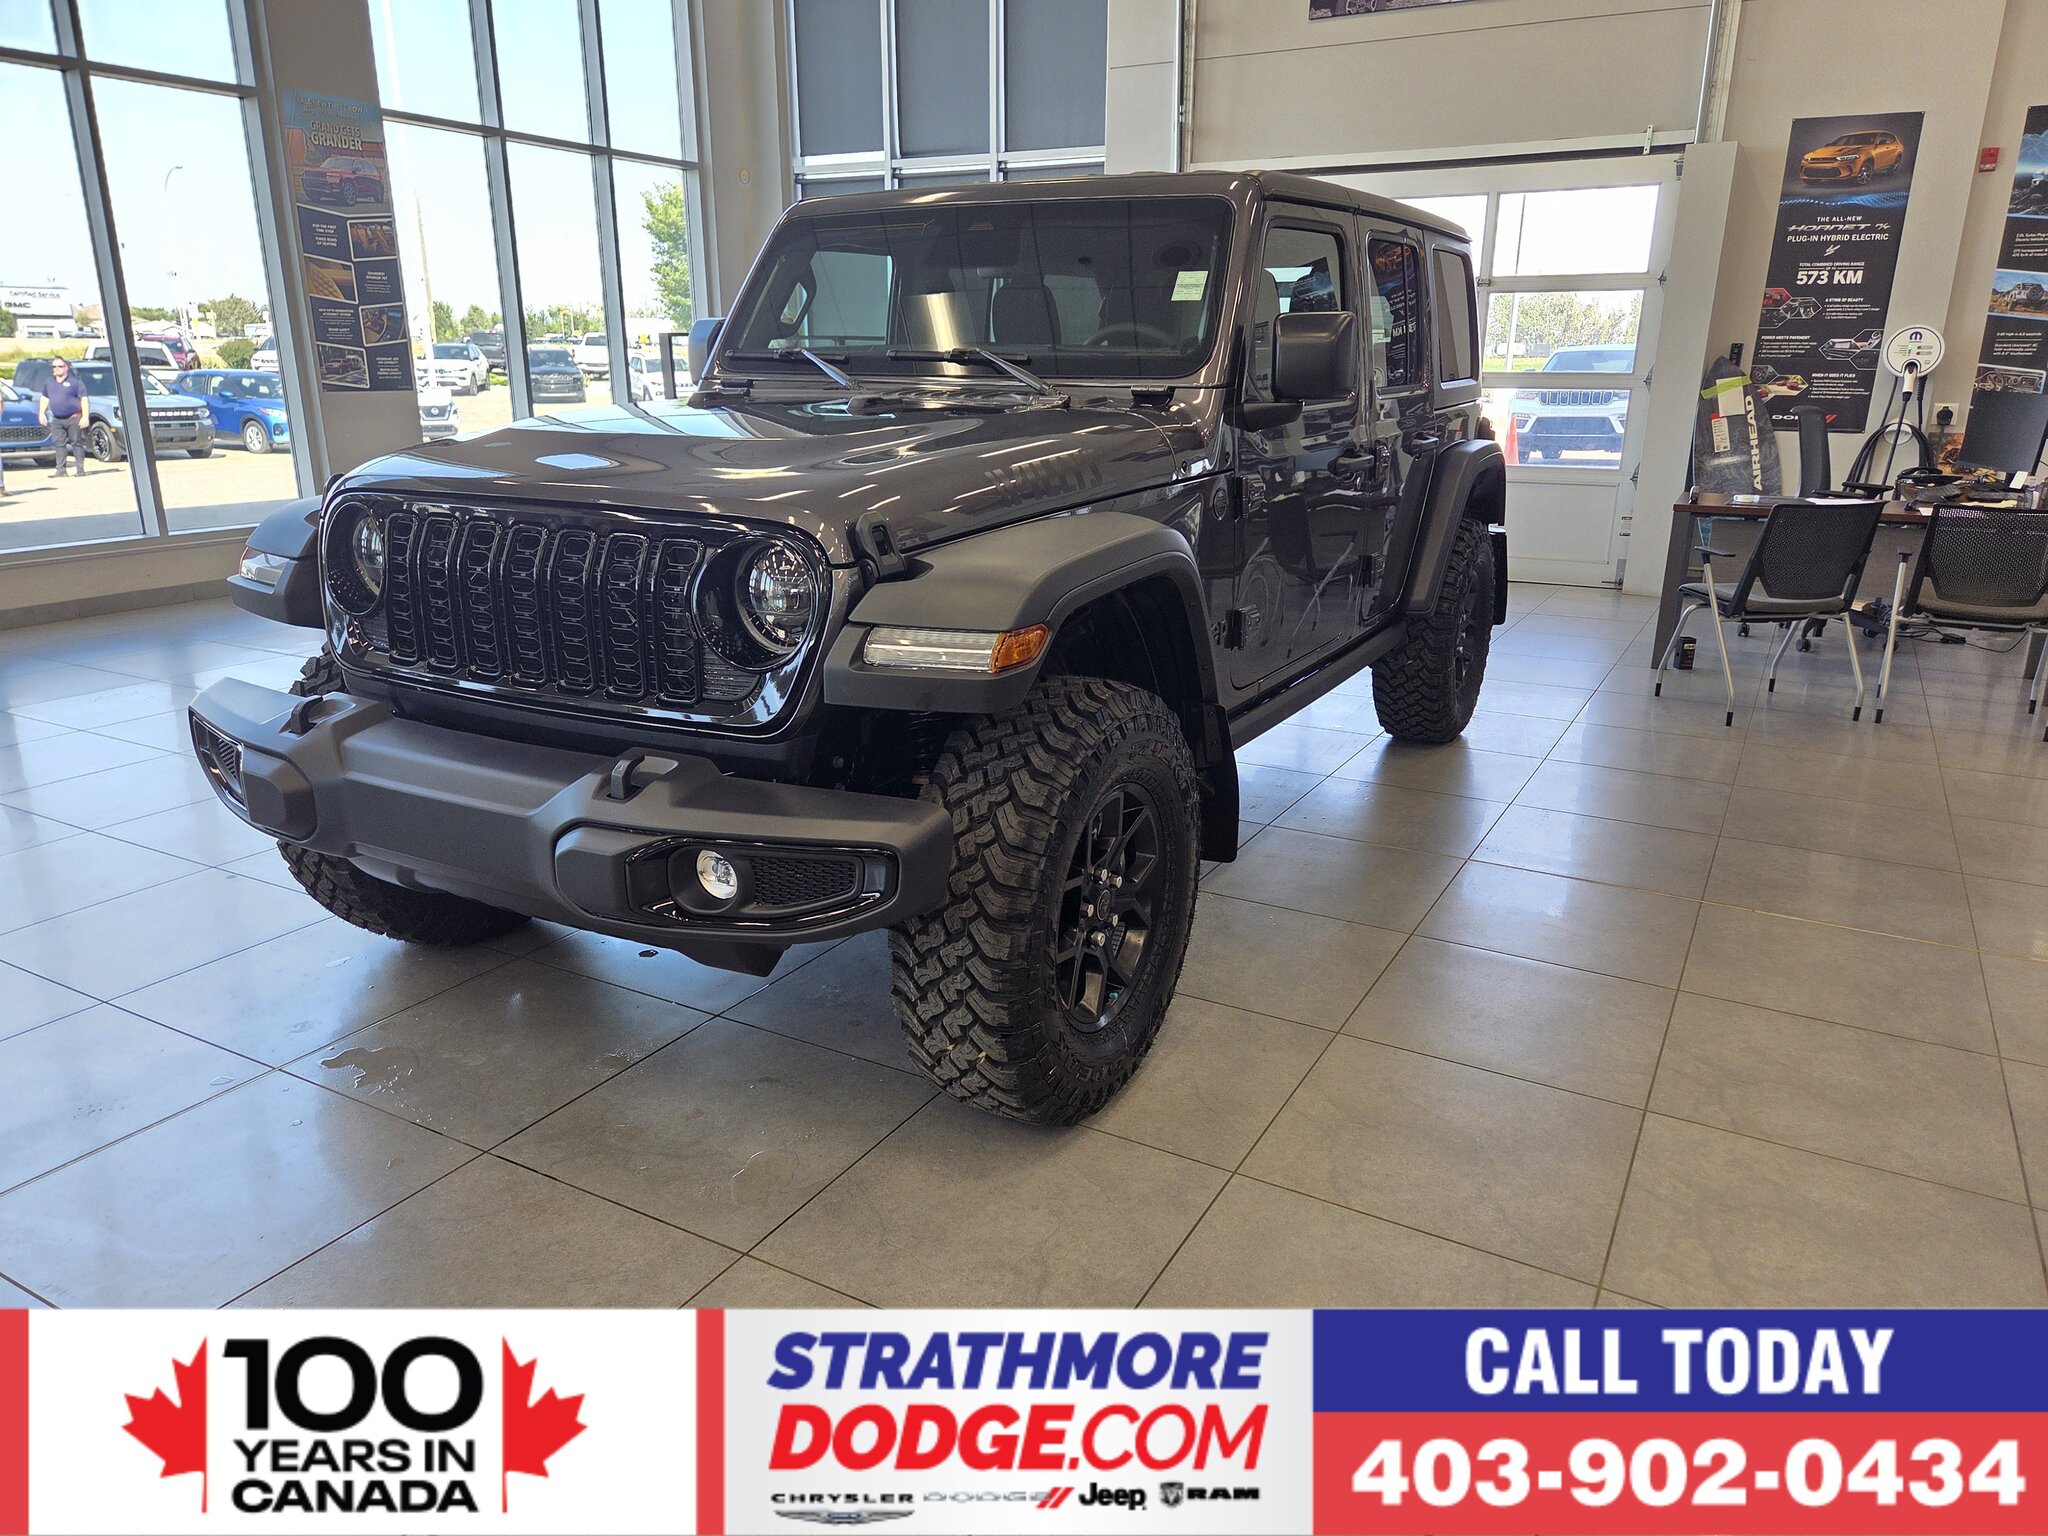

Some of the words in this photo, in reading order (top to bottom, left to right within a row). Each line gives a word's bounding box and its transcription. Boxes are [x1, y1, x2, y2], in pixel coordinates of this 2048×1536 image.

[309, 120, 339, 133] GRAND
[340, 124, 361, 137] GETS
[311, 131, 363, 151] GRANDER
[1788, 223, 1871, 232] HORNET
[1851, 233, 1889, 241] ELECTRIC
[1796, 270, 1829, 285] 573
[1833, 270, 1864, 285] KM
[1745, 395, 1763, 491] AIRHEAD
